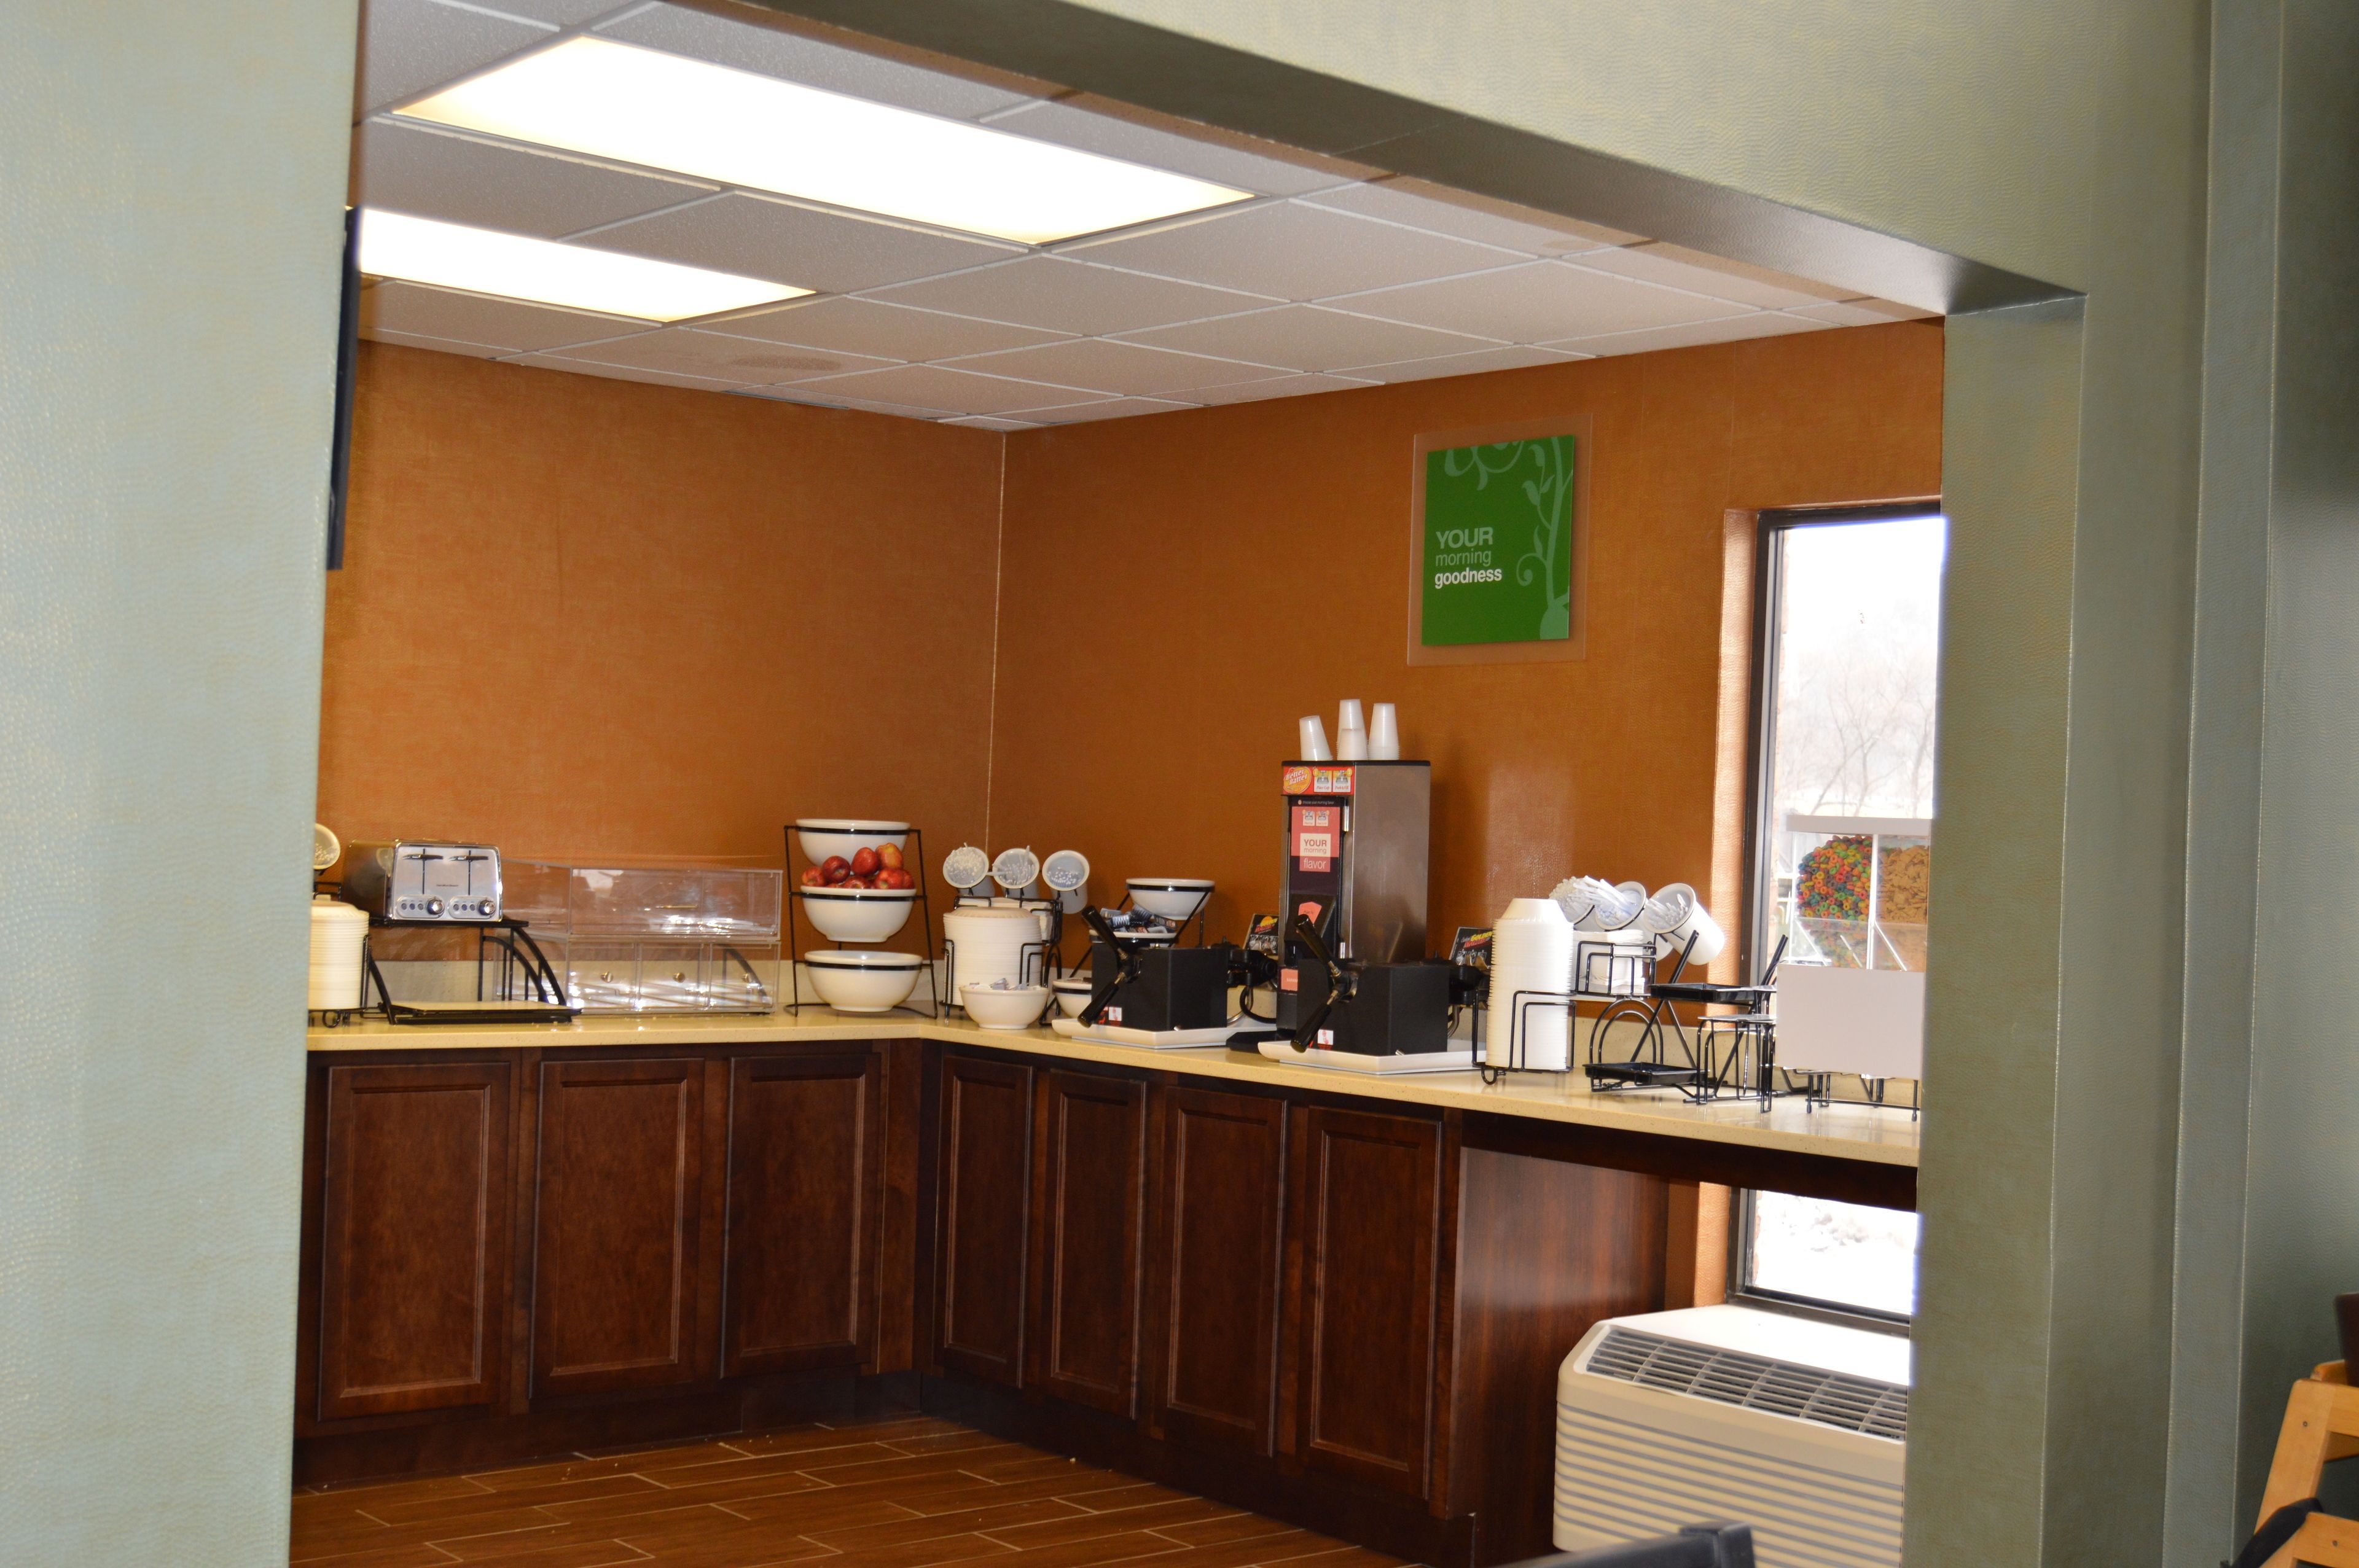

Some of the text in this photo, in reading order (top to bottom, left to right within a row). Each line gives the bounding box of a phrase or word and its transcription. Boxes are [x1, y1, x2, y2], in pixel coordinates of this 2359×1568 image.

[1436, 527, 1493, 549] YOUR
[1436, 548, 1492, 567] morning
[1434, 567, 1503, 589] goodness
[1304, 857, 1327, 869] flavor
